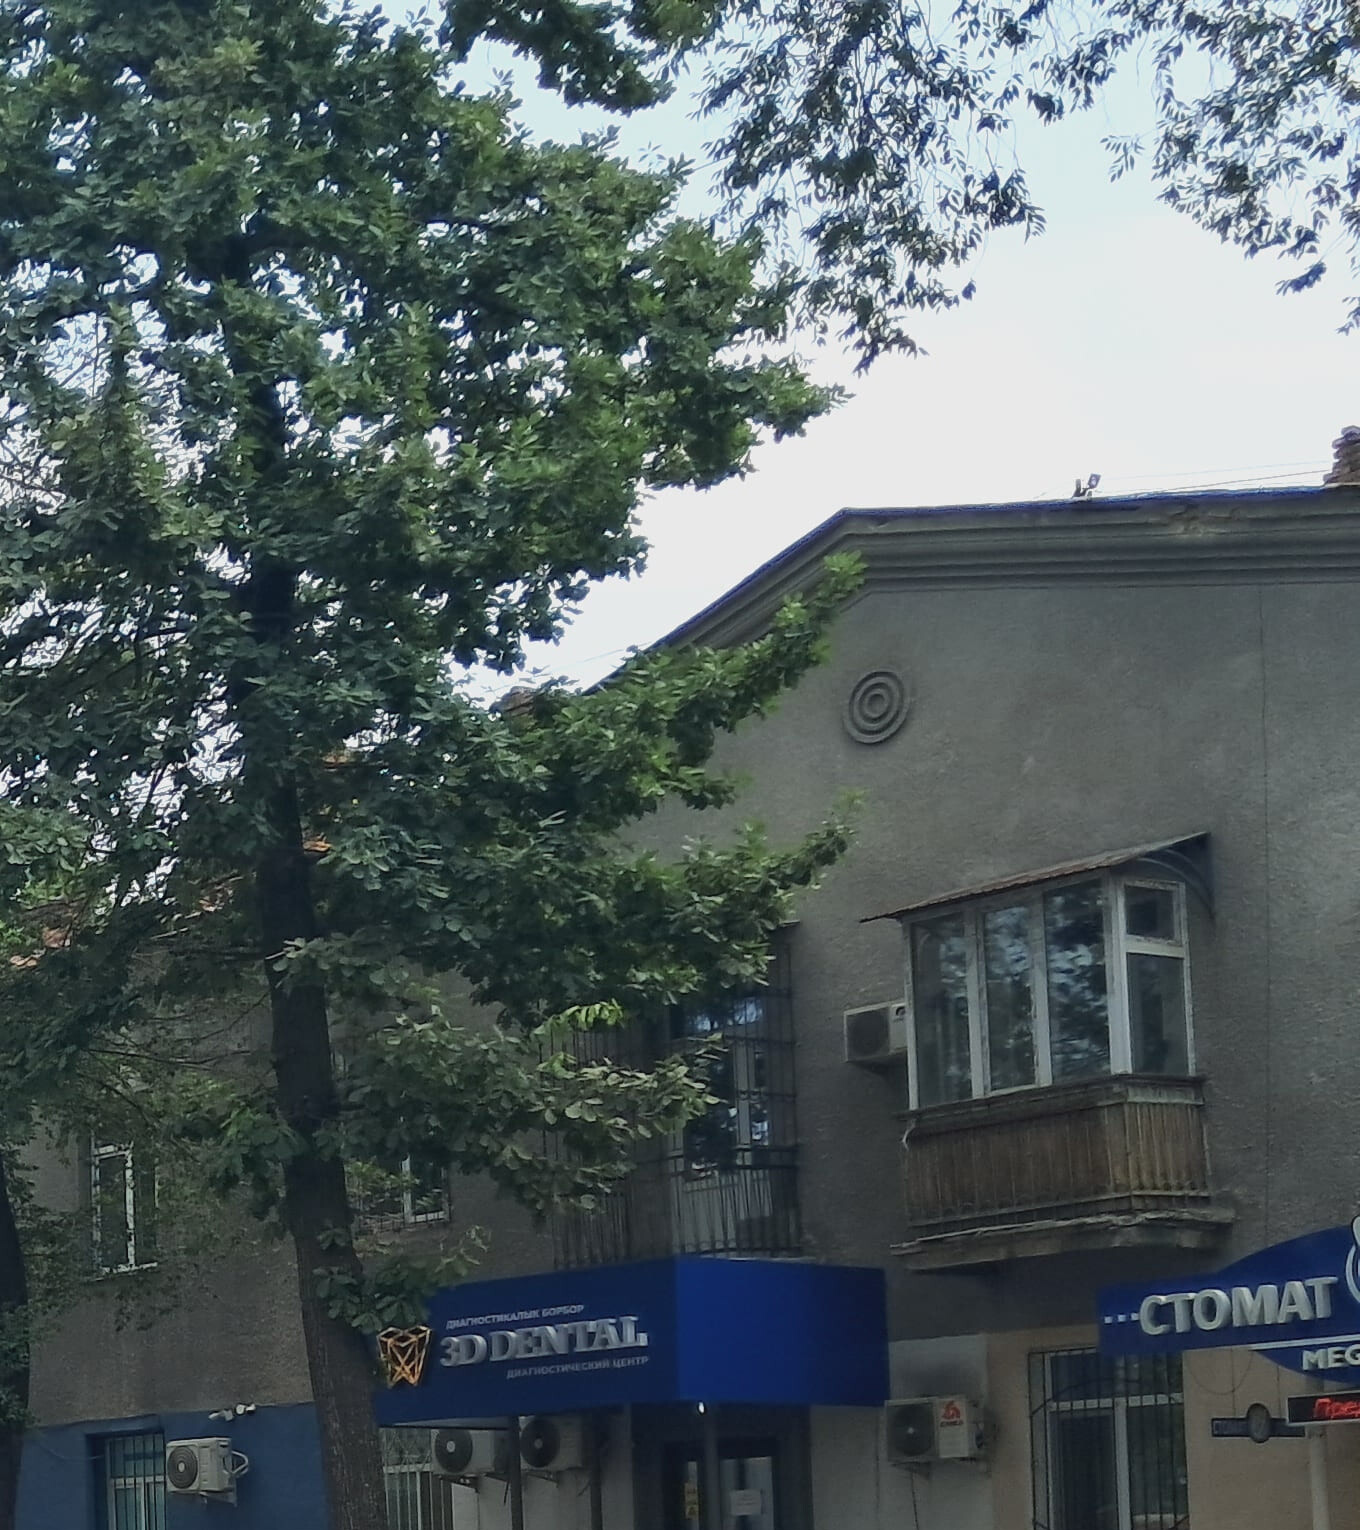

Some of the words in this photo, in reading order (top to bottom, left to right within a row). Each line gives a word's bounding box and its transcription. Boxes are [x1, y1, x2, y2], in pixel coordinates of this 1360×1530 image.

[541, 1304, 585, 1318] БОРБОР
[439, 1333, 488, 1367] 3D
[489, 1315, 649, 1362] DENTAL
[506, 1358, 611, 1380] ДИАГНОСТИЧЕСКИЙ
[613, 1355, 650, 1369] ЦЕНТР
